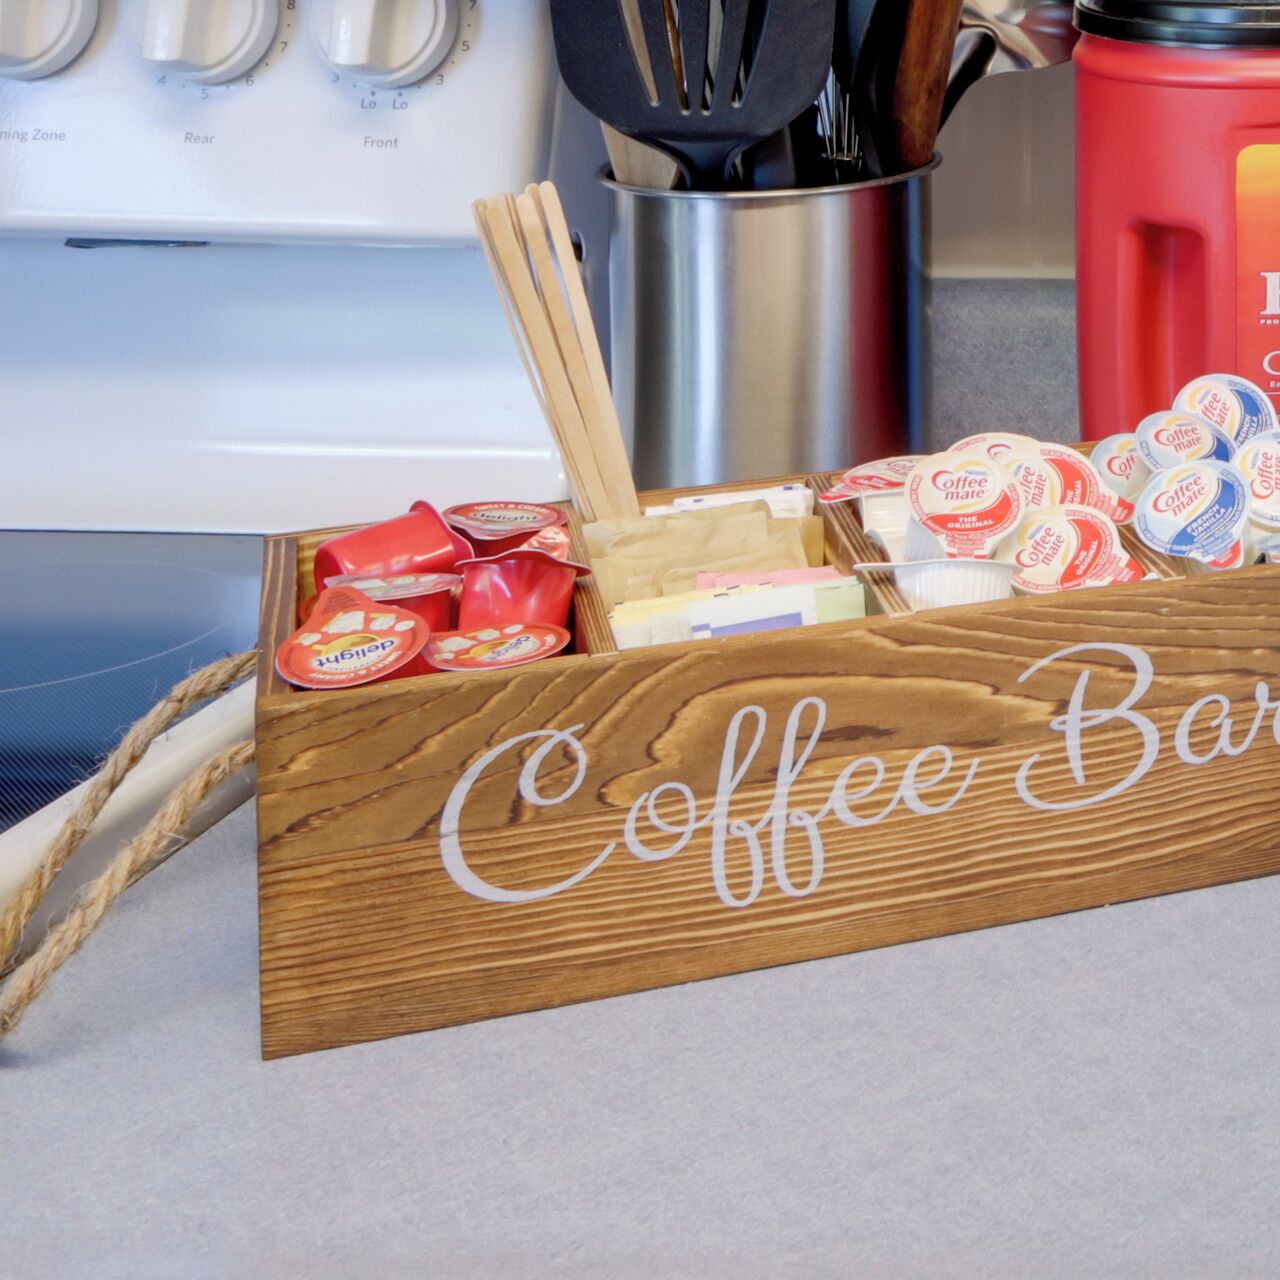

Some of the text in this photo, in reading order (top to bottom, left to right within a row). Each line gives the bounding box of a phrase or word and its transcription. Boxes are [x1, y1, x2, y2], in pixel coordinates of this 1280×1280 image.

[286, 0, 296, 10] 8
[468, 0, 477, 11] 7
[280, 41, 288, 53] 7
[462, 41, 470, 51] 5
[157, 74, 167, 85] 4
[246, 74, 254, 86] 6
[436, 74, 444, 85] 3
[201, 88, 209, 100] 5
[361, 99, 377, 110] Lo
[392, 99, 408, 110] Lo
[32, 129, 66, 141] Zone
[184, 132, 215, 144] Rear
[363, 137, 399, 149] Front
[1154, 425, 1200, 446] Coffee
[1173, 436, 1203, 452] mate
[1107, 455, 1135, 477] Coff
[931, 470, 988, 491] Coffee
[1250, 452, 1274, 499] Coffee
[944, 489, 985, 501] mate
[1031, 473, 1047, 506] mate
[1153, 475, 1202, 513] Coffee
[1171, 485, 1206, 518] mate
[947, 519, 994, 529] ORIGINAL
[1187, 504, 1221, 533] FRENCH
[1191, 508, 1226, 537] VANILLA
[1015, 527, 1055, 568] Coffee
[1041, 534, 1065, 566] mate
[1074, 550, 1087, 565] THE
[1076, 539, 1098, 575] ORIGINAL
[317, 638, 395, 667] delight
[440, 696, 980, 908] Coffee
